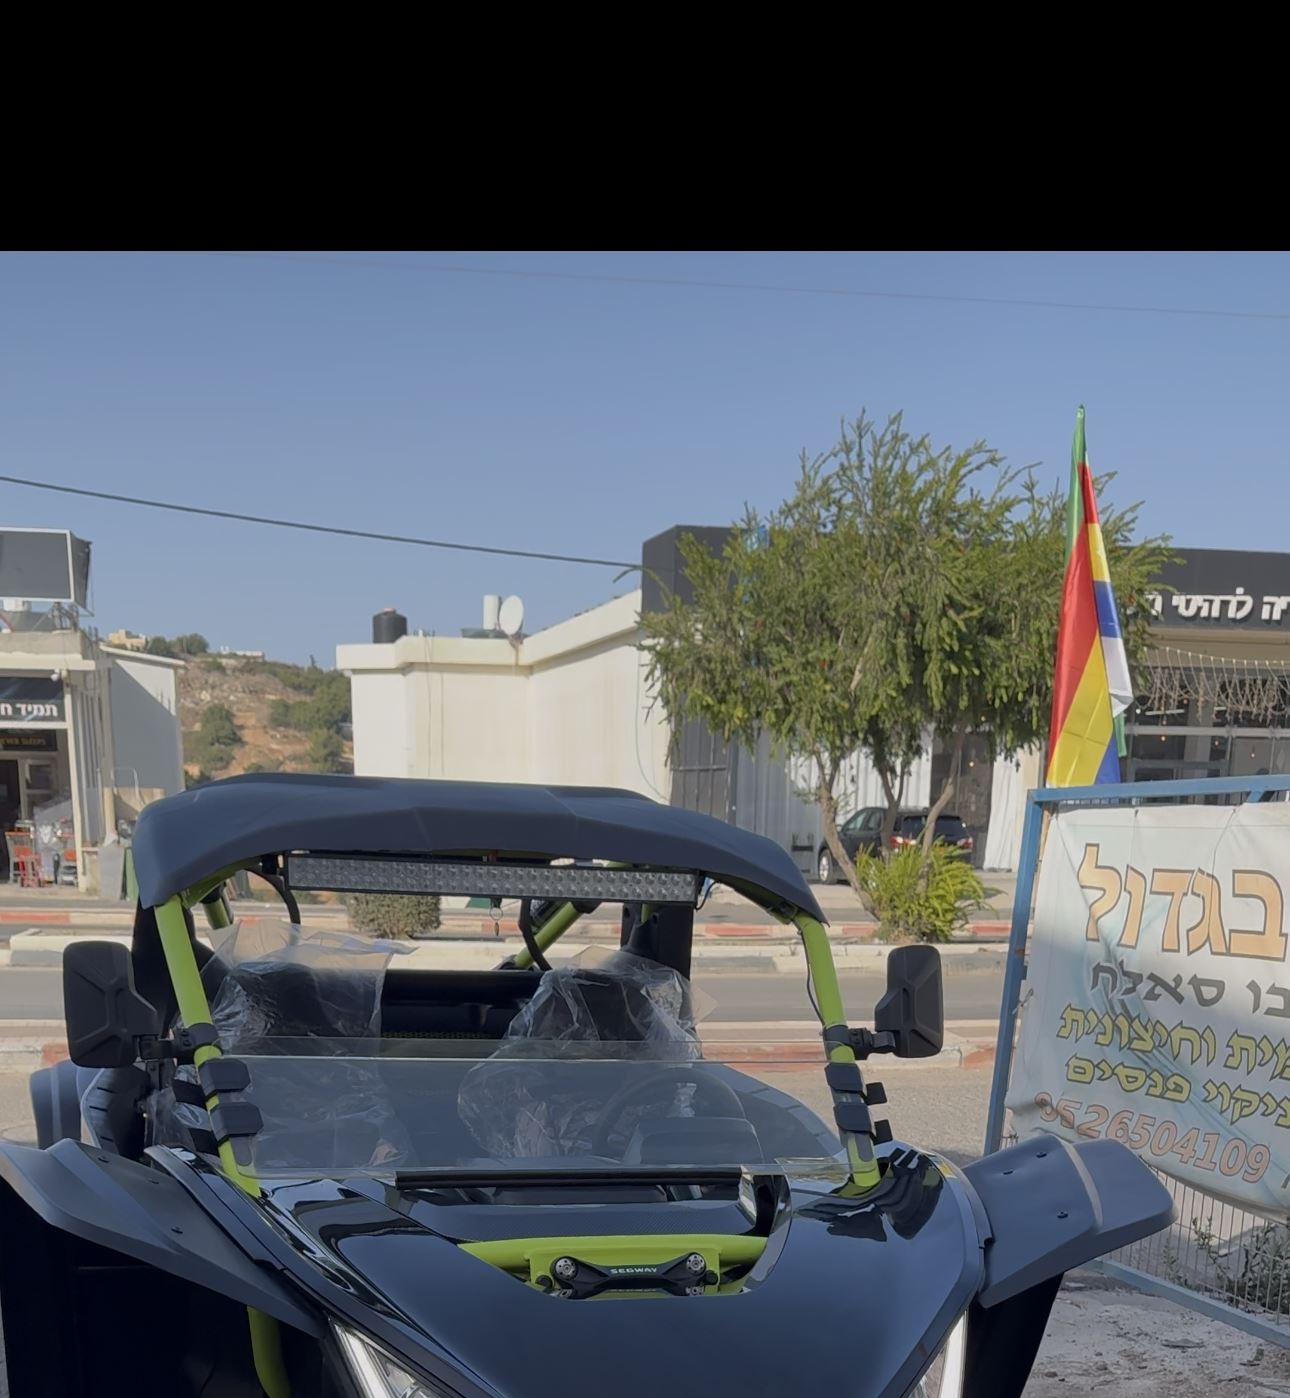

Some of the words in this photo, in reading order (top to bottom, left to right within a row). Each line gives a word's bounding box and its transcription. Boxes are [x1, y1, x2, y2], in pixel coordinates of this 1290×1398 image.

[15, 703, 58, 717] תמיד
[1077, 843, 1288, 962] בגדול
[1056, 1003, 1216, 1066] וחיצונית
[1065, 1053, 1191, 1103] פנסים
[1202, 1079, 1290, 1128] ניקוי
[1034, 1092, 1271, 1183] 0526504109
[609, 1267, 658, 1275] SEGWAY
